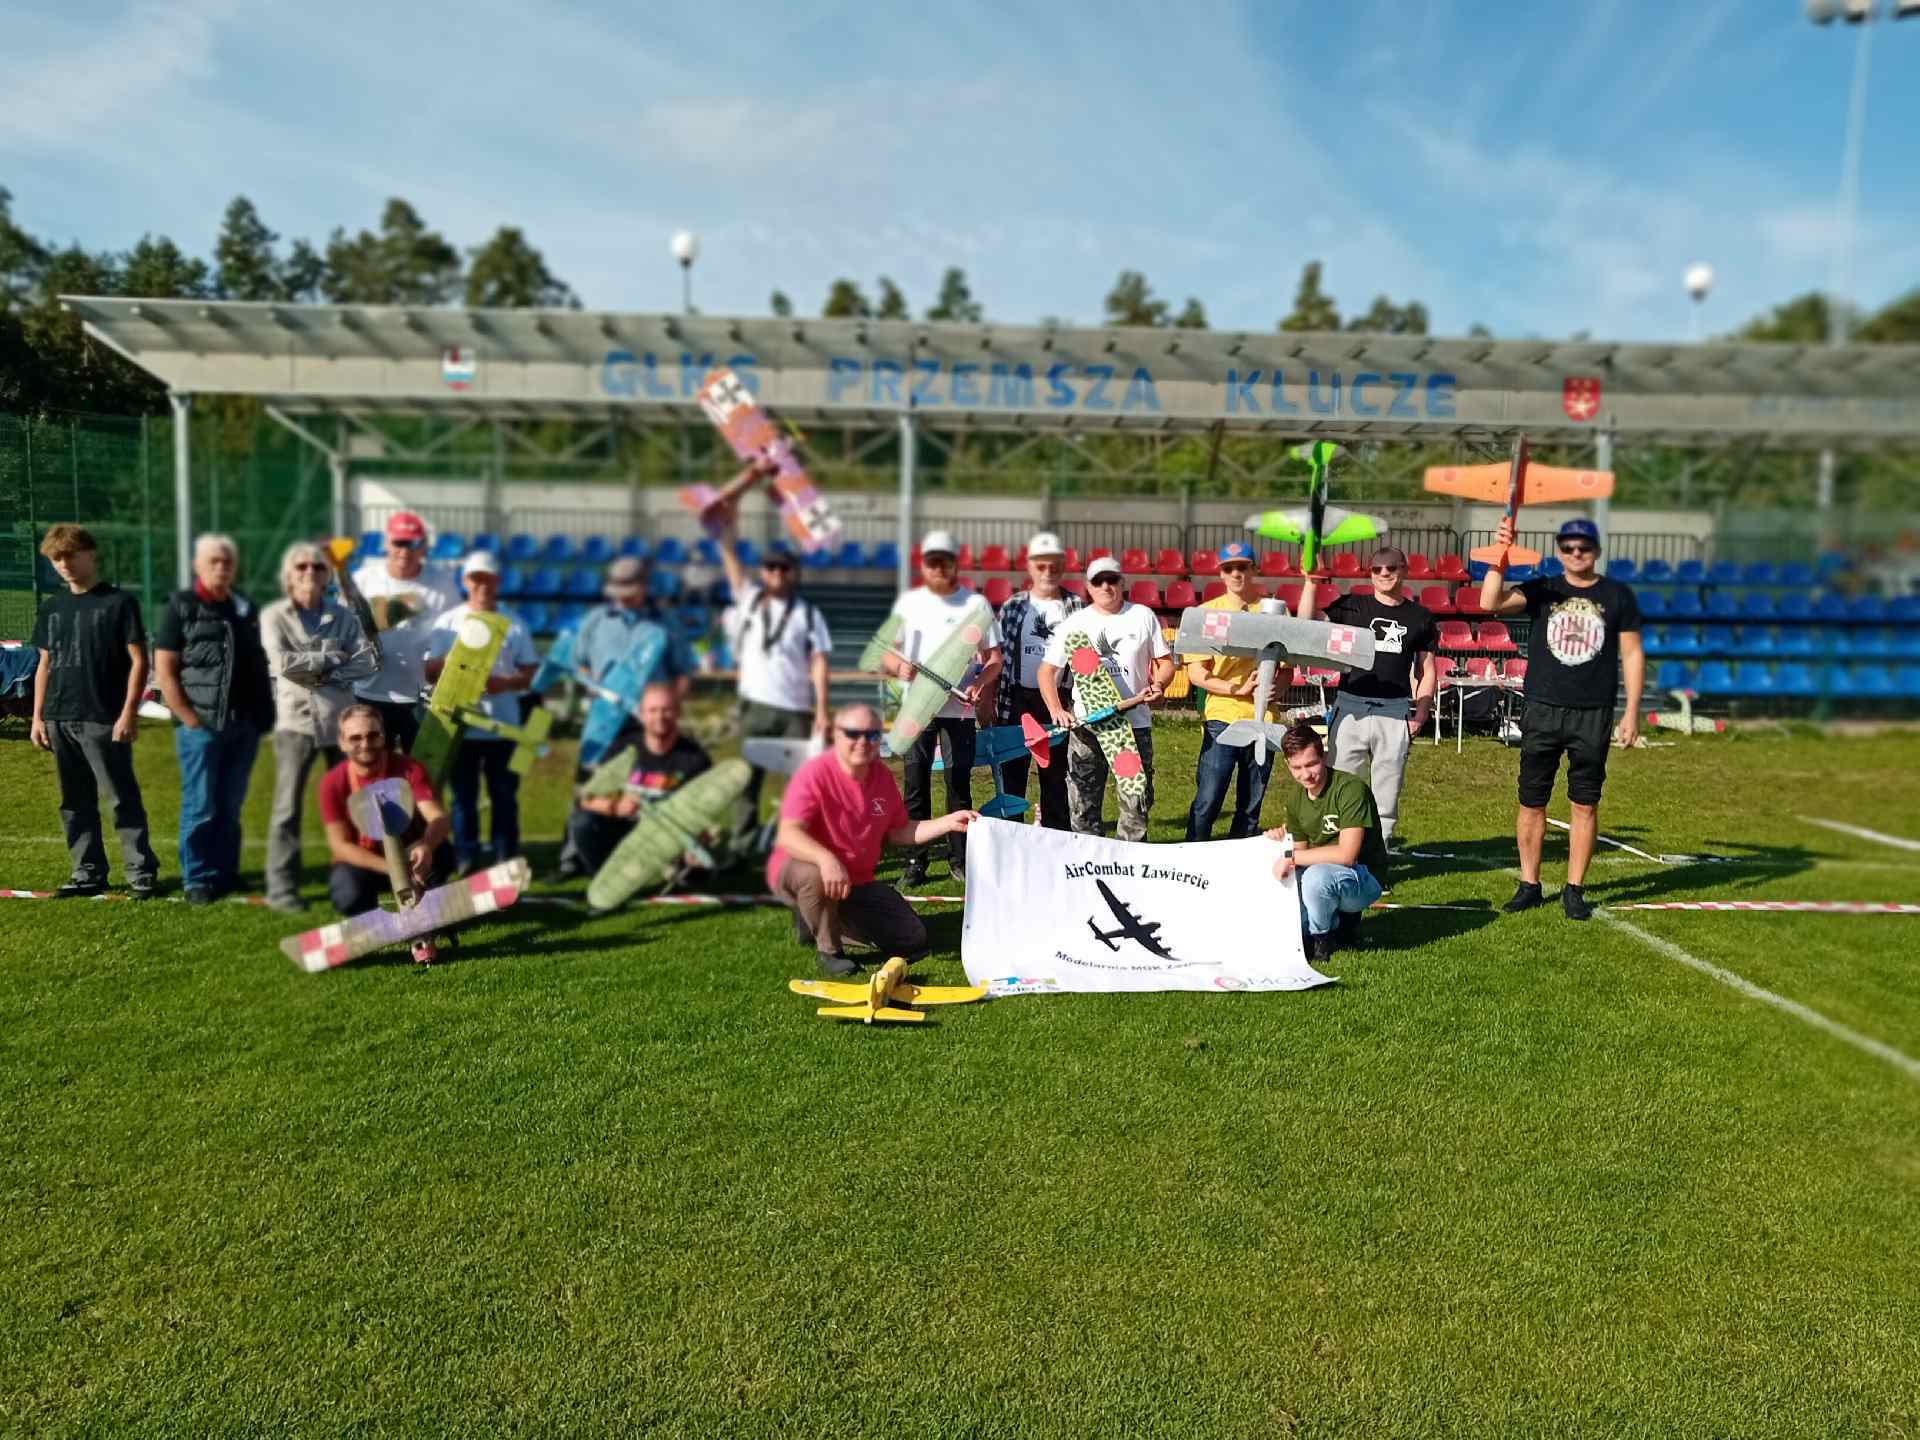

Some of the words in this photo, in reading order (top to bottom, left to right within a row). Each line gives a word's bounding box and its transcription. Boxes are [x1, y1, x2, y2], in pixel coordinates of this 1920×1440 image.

[828, 357, 1161, 410] PRZEMSZA
[1225, 367, 1457, 418] KLUCZE
[1065, 861, 1135, 879] AirCombat
[1141, 864, 1210, 890] Zawiercie
